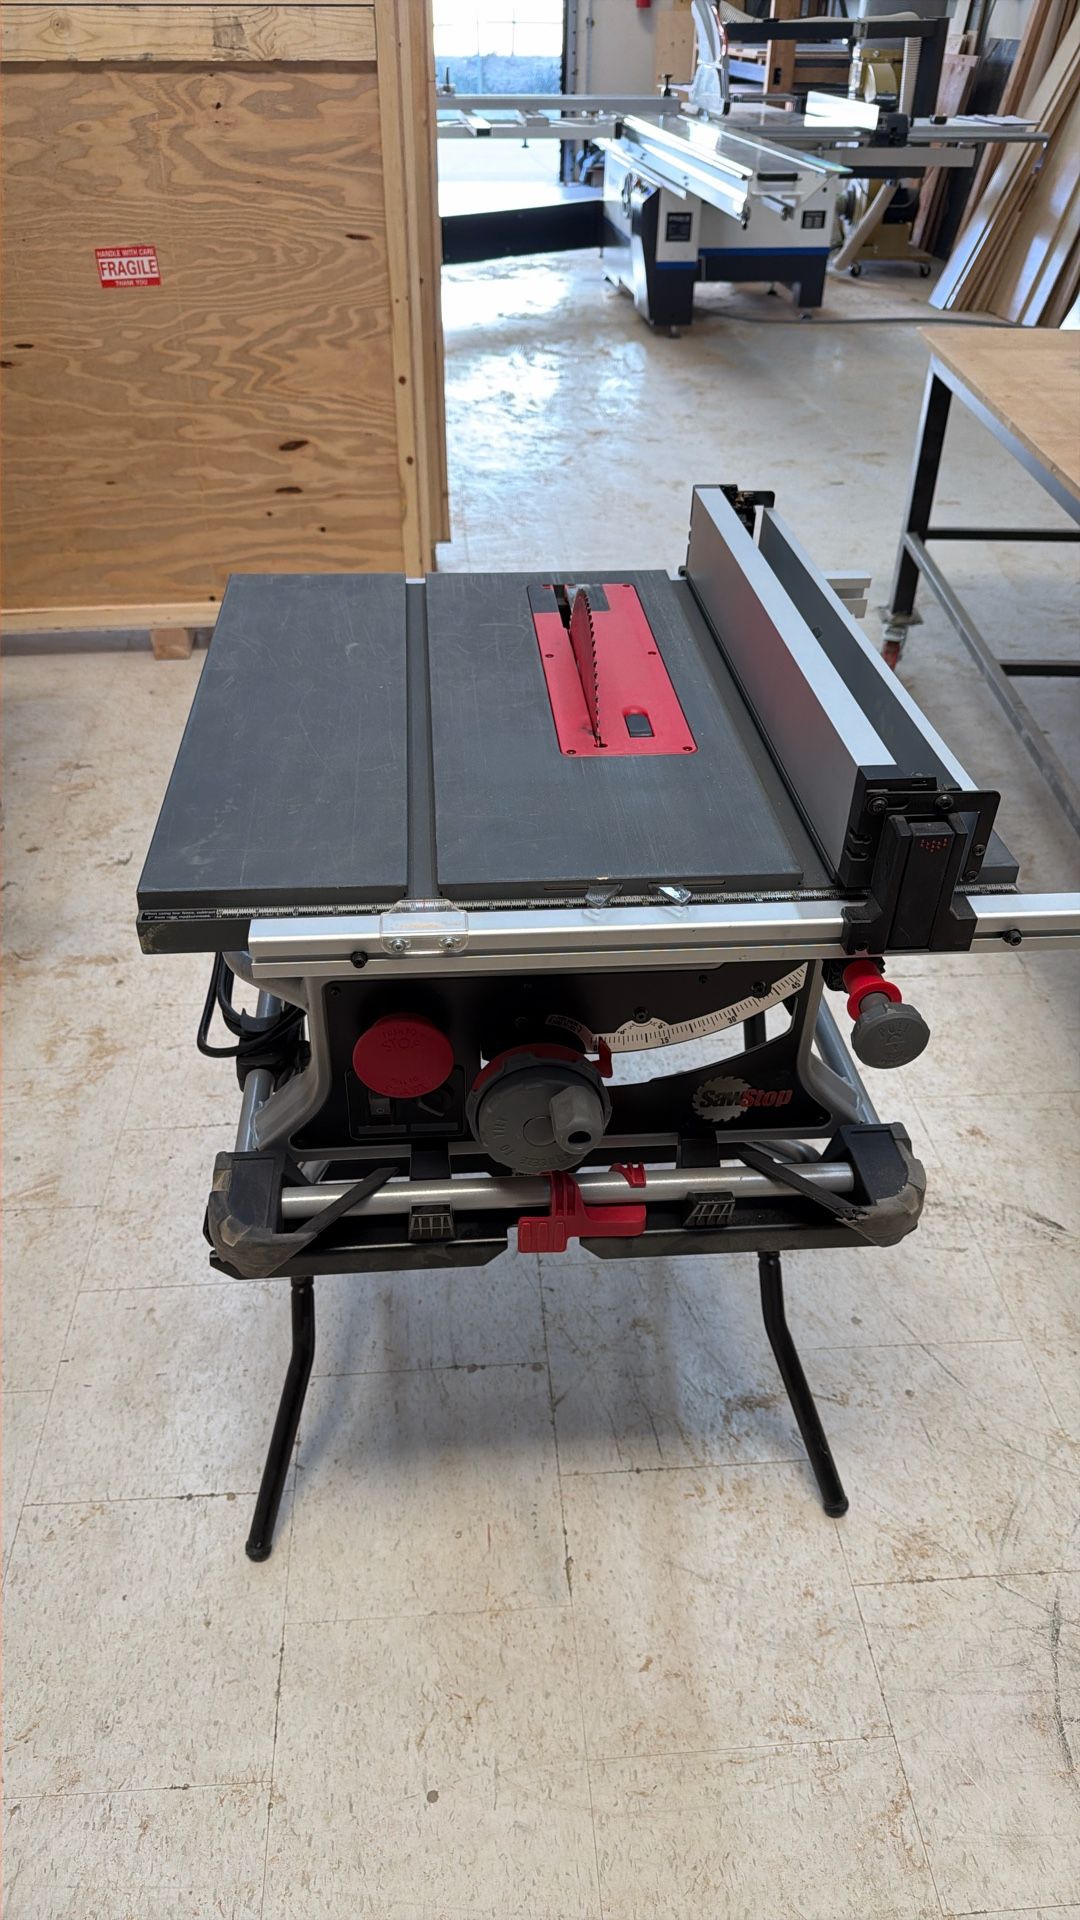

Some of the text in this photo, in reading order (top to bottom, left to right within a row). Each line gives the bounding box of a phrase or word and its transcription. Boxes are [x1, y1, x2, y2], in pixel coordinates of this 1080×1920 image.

[96, 249, 121, 257] HANDLE
[122, 248, 138, 256] WITH
[100, 260, 157, 276] FRAGILE
[792, 982, 801, 990] 45
[727, 1016, 737, 1024] 30
[660, 1036, 669, 1044] 15
[382, 1038, 421, 1052] STOP
[699, 1088, 793, 1107] SawStop
